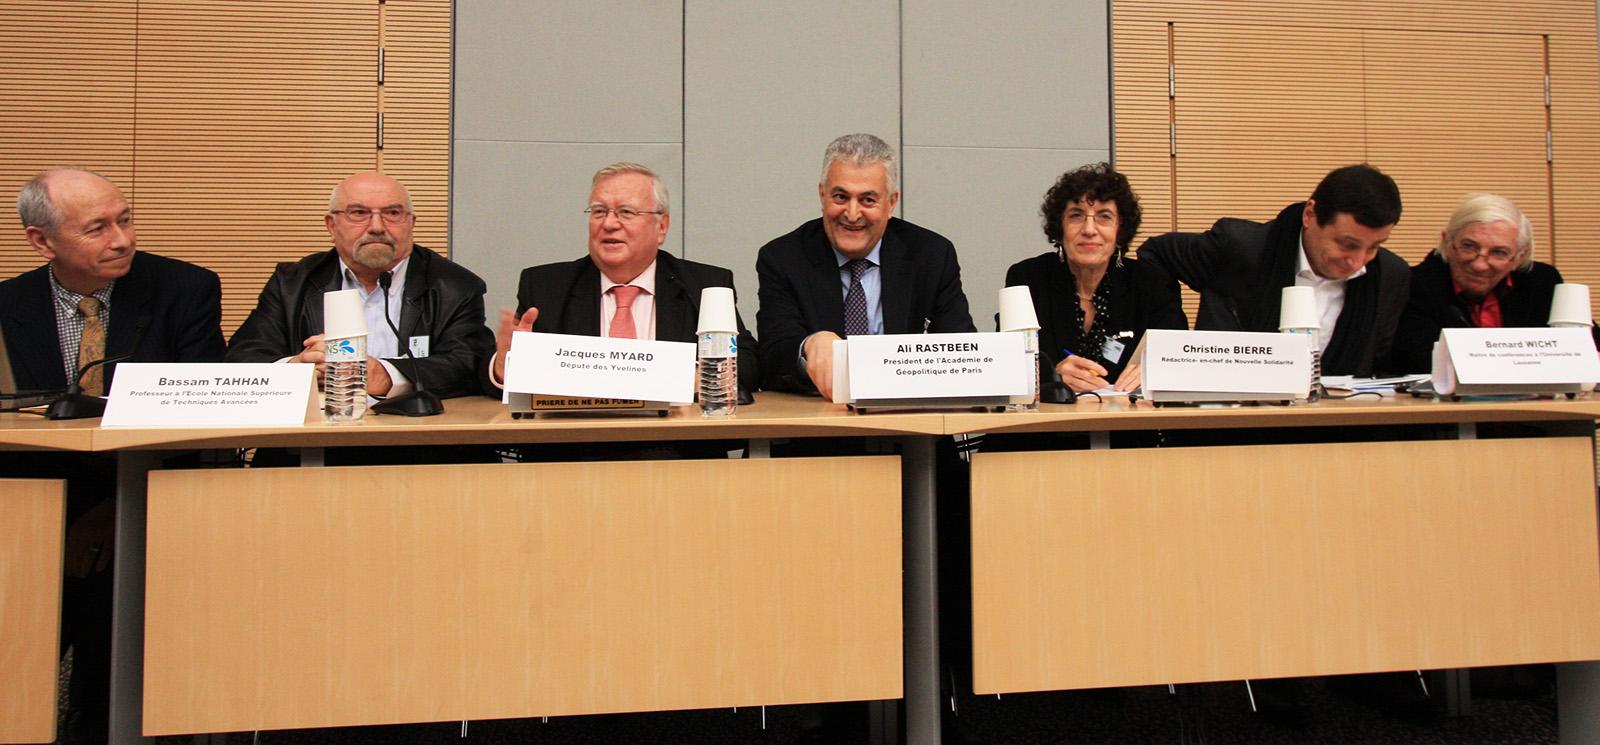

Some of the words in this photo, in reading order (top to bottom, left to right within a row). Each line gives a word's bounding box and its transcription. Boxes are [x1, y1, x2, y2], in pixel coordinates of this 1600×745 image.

[897, 344, 912, 353] Ali
[915, 342, 979, 353] RASTBEEN
[1183, 344, 1230, 354] Christine
[1233, 345, 1273, 355] BIERRE
[1485, 340, 1523, 348] Bernard
[1525, 340, 1557, 348] WICHT
[555, 348, 606, 360] Jacques
[609, 351, 654, 362] MYARD
[924, 357, 935, 365] de
[560, 361, 591, 370] Député
[592, 363, 608, 371] des
[610, 364, 647, 373] Yvelines
[158, 377, 210, 386] Bassam
[214, 377, 270, 386] TAHHAN
